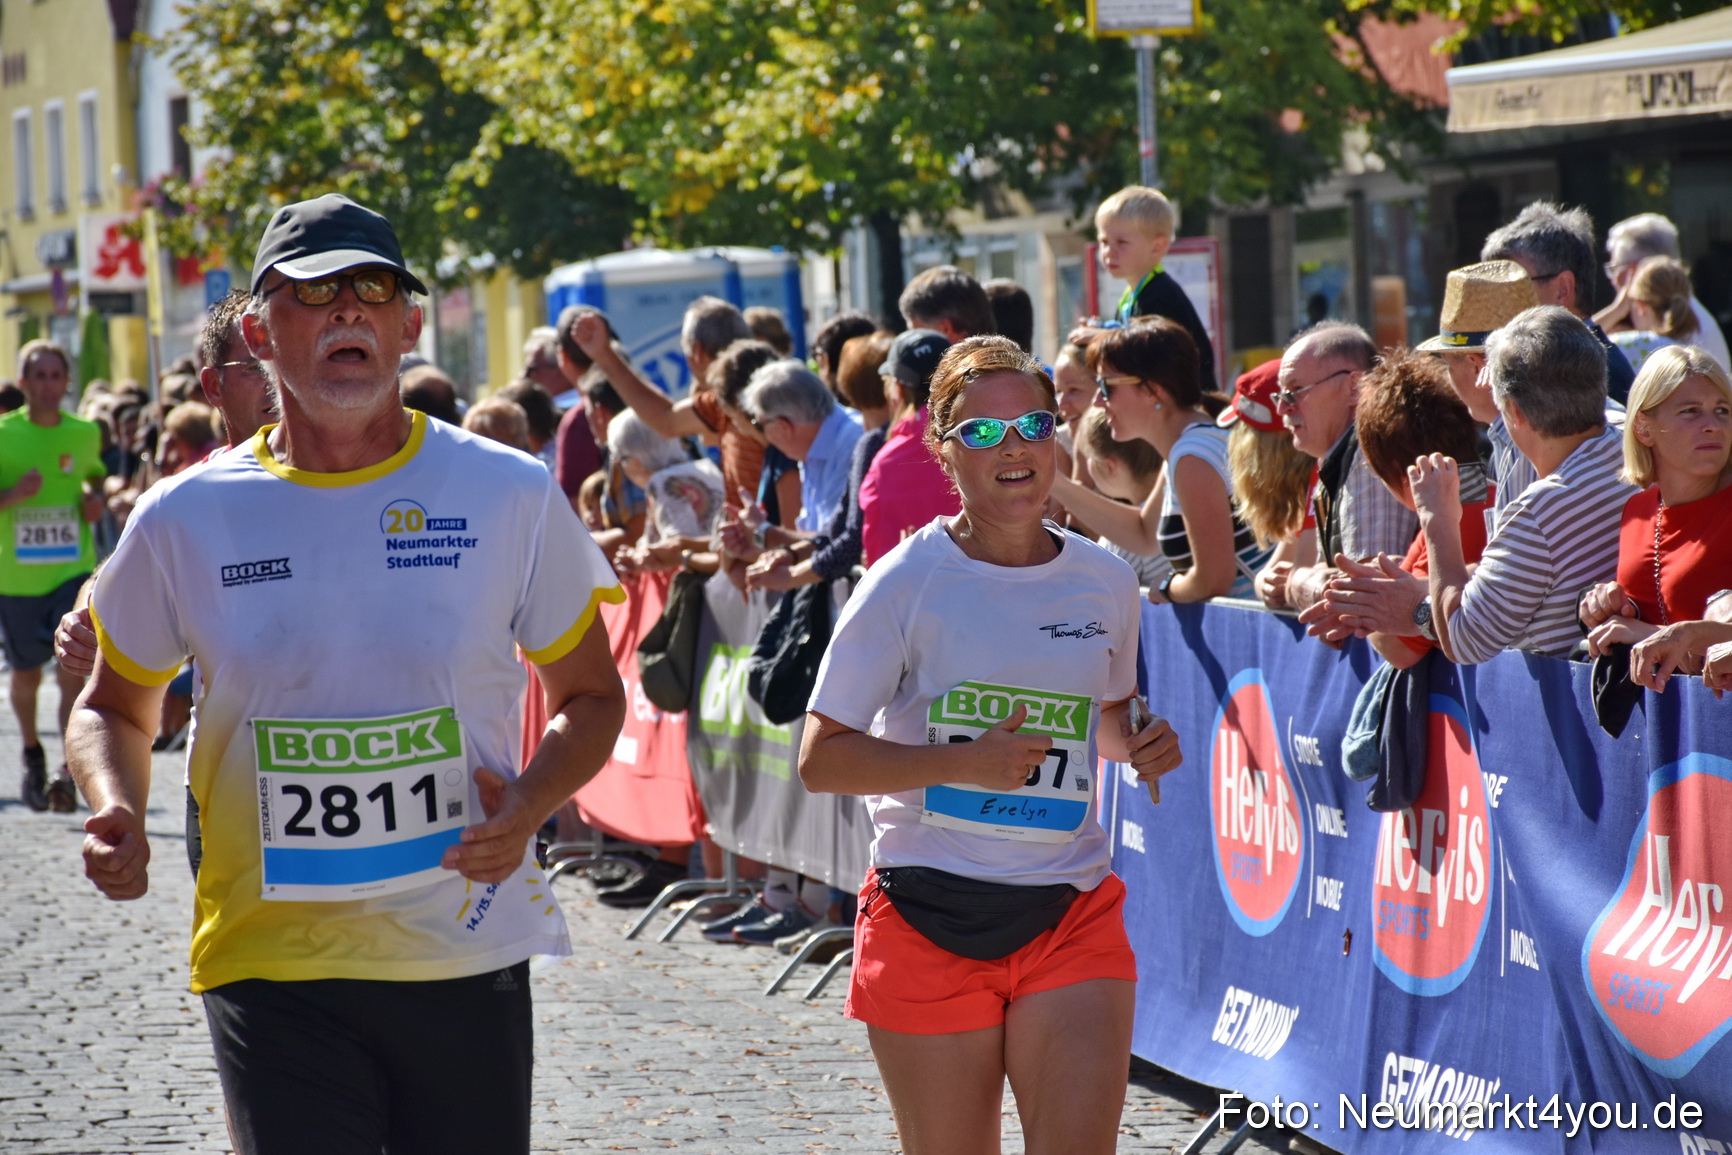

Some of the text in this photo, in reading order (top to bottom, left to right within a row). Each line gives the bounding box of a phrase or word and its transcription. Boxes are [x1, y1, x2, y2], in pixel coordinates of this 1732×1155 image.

[22, 526, 75, 545] 2816
[386, 508, 464, 534] 20 JAHRE
[386, 535, 478, 551] Neumarkter
[222, 557, 291, 581] BOCK
[387, 553, 461, 569] Stadtlauf
[943, 688, 1079, 734] BOCK
[269, 717, 445, 765] BOCK
[1294, 734, 1323, 767] STORE
[281, 774, 438, 838] 2811
[980, 798, 1047, 821] Evelyn
[1220, 729, 1299, 876] Hervis
[1315, 803, 1348, 838] ONLINE
[1230, 852, 1262, 886] SPORTS
[1316, 875, 1344, 911] MOBILE
[1377, 899, 1431, 939] SPORTS
[1510, 929, 1540, 971] MOBILE
[1608, 972, 1673, 1016] SPORTS
